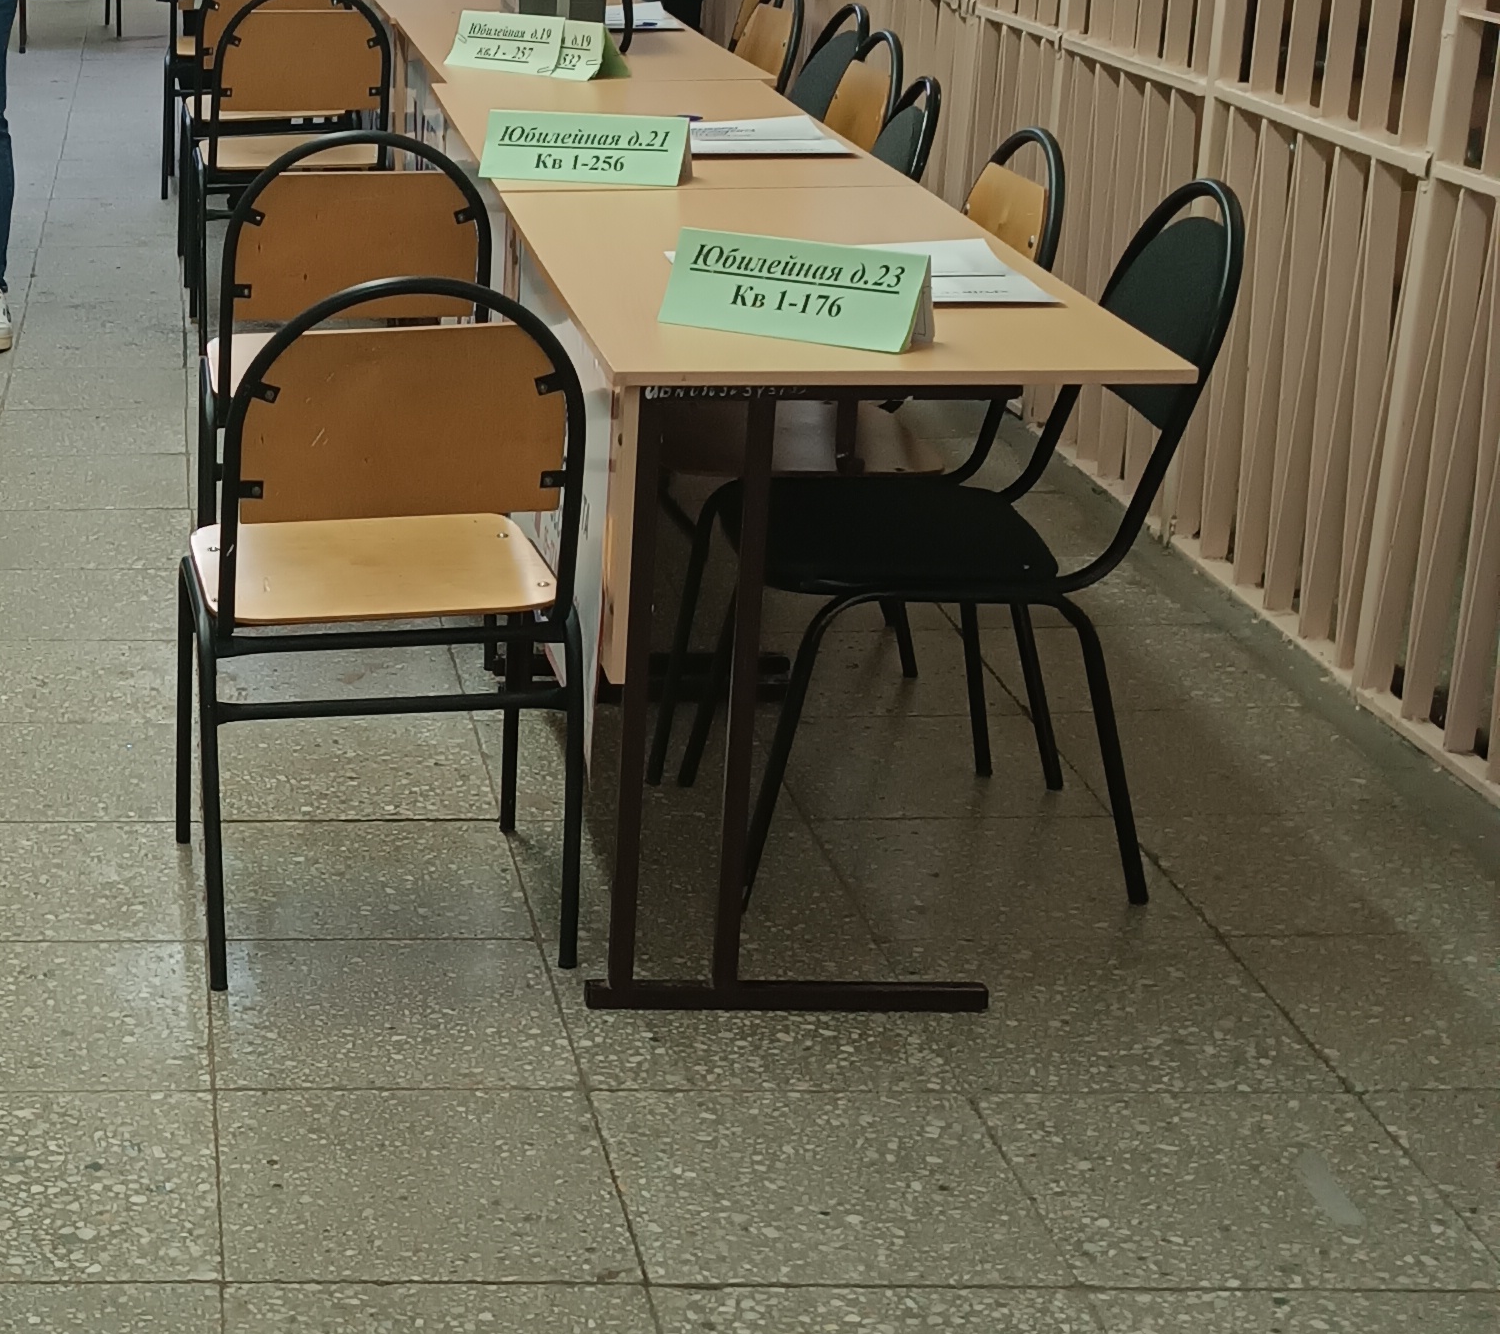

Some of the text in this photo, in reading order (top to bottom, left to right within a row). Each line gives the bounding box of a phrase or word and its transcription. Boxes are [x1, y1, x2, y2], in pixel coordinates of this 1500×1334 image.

[468, 22, 552, 41] Юбилейная д.19
[515, 47, 534, 61] 257
[499, 125, 621, 147] Юбилейная
[627, 130, 670, 149] д.21
[534, 153, 625, 172] Кв 1-256
[691, 244, 906, 289] Юбилейная д.23
[730, 284, 846, 318] Кв 1-176
